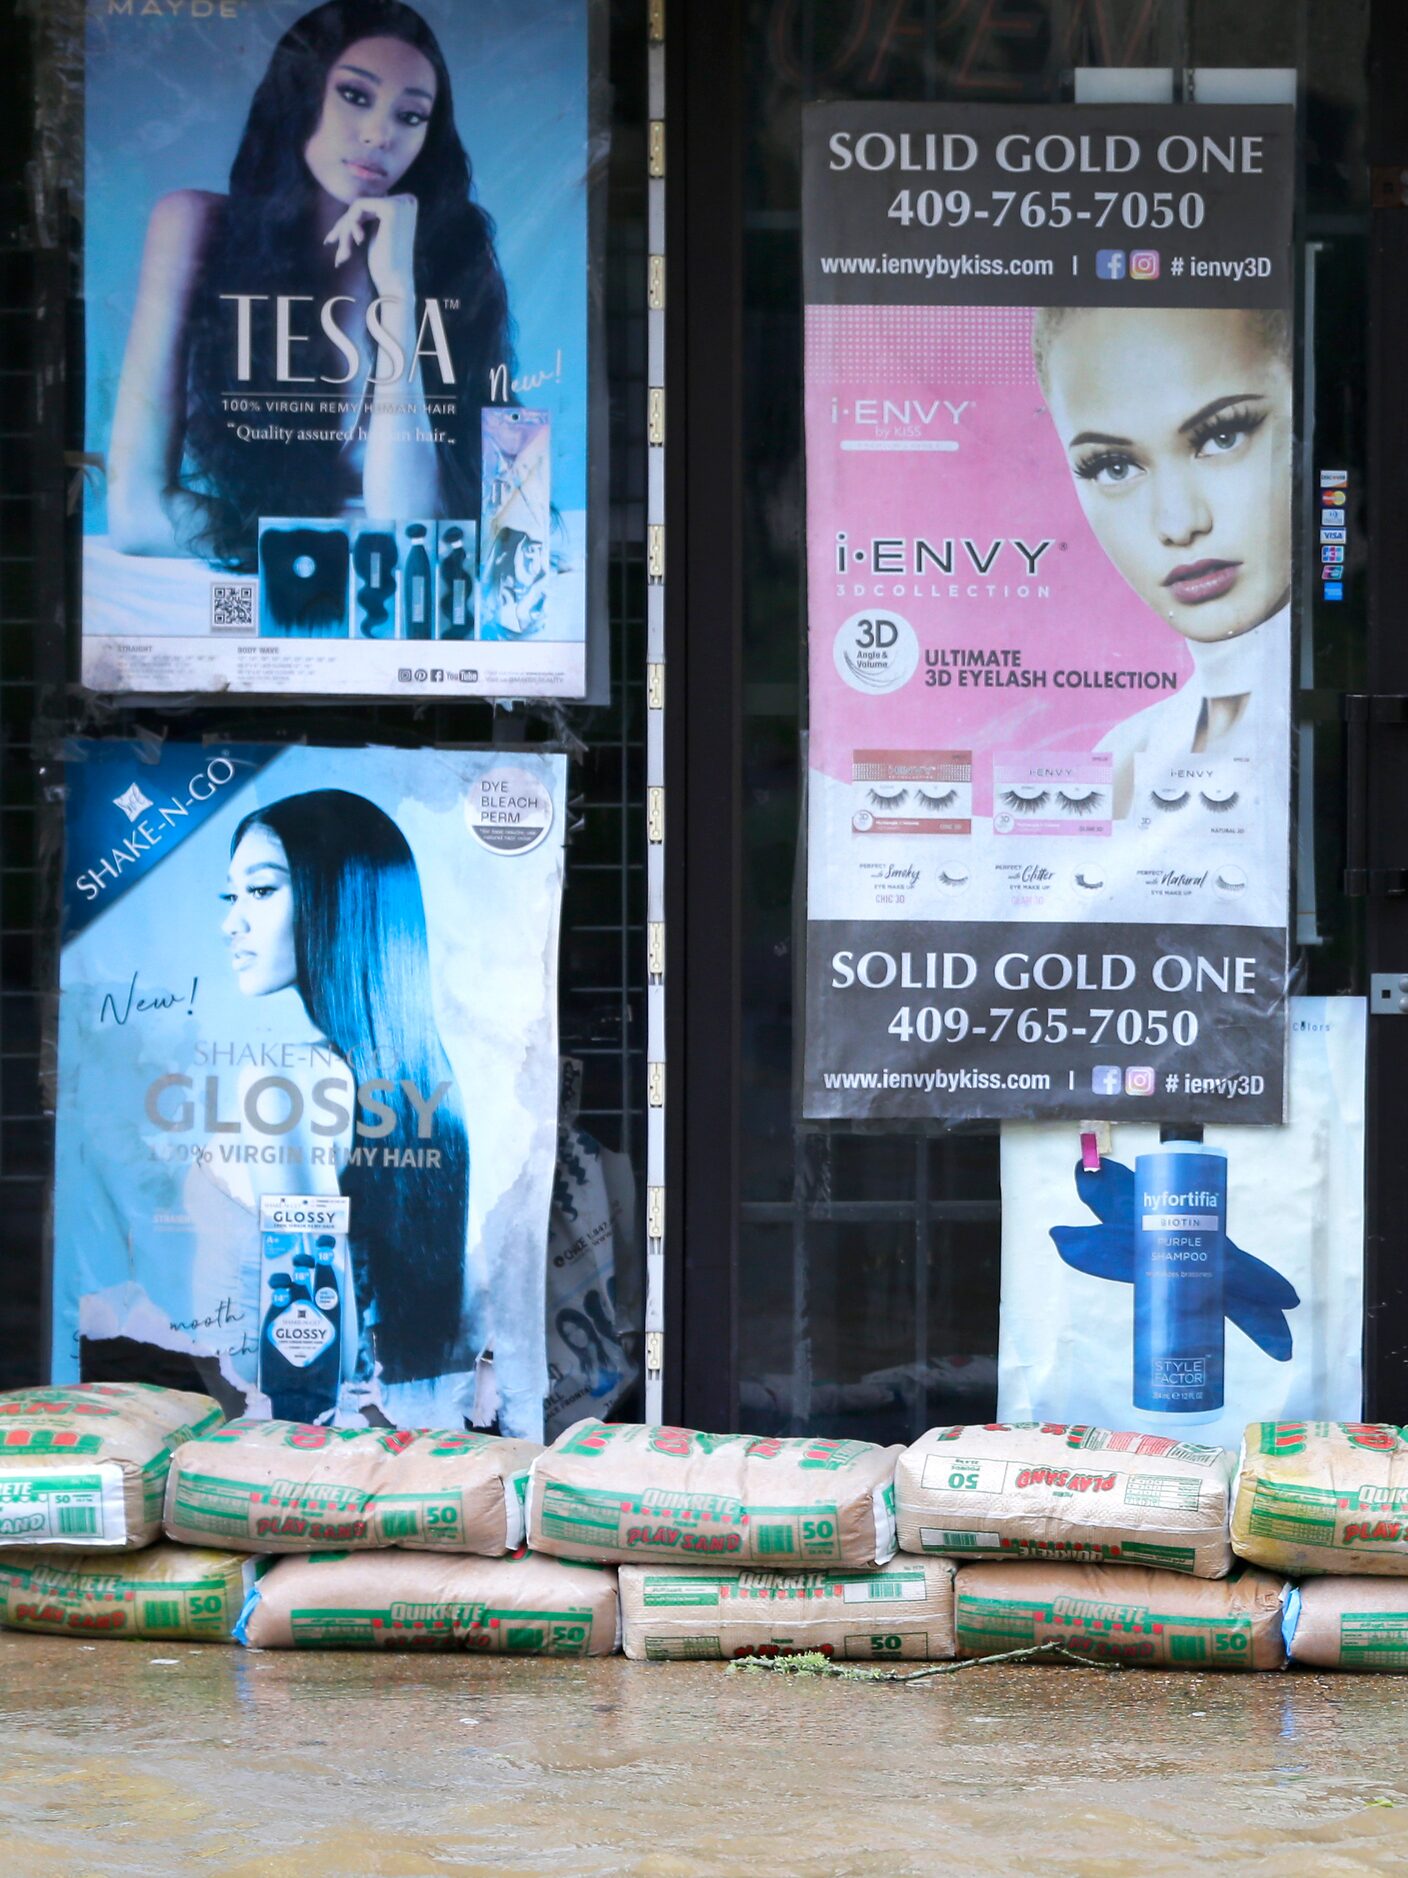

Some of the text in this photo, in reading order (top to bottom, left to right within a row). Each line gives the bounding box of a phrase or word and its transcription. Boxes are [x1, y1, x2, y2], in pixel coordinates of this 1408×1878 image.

[829, 132, 1263, 174] SOLID GOLD ONE
[887, 189, 1205, 229] 409-765-7050
[821, 255, 1271, 281] www.ienvybykiss.com ienvy3D
[488, 349, 562, 402] New!
[222, 401, 260, 412] 100%
[266, 402, 314, 413] VIRGIN
[320, 402, 357, 414] REMY
[423, 404, 456, 414] HAIR
[297, 426, 352, 441] assured
[855, 619, 898, 648] 3D
[857, 651, 880, 660] Angle
[857, 660, 888, 669] Volume
[925, 649, 1021, 667] ULTIMATE
[925, 671, 1177, 690] 3D EYELASH COLLECTION
[481, 781, 509, 793] DYE
[481, 796, 538, 809] BLEACH
[481, 811, 521, 823] PERM
[75, 757, 235, 901] SHAKE-N-GO
[885, 864, 920, 882] Smoky
[1021, 865, 1055, 882] Glitter
[1161, 871, 1207, 888] Natural
[831, 950, 1256, 995] SOLID GOLD ONE
[100, 973, 200, 1027] New!
[888, 1007, 1199, 1046] 409-765-7050
[824, 1069, 1264, 1097] www.ienvybykiss.com ienvy3D
[144, 1073, 453, 1139] GLOSSY
[219, 1144, 304, 1165] VIRGIN
[384, 1147, 442, 1169] HAIR
[273, 1211, 335, 1223] GLOSSY
[1160, 1219, 1200, 1227] BIOTIN
[1158, 1237, 1202, 1247] PURPLE
[1151, 1252, 1208, 1262] SHAMPOO
[276, 1328, 328, 1339] GLOSSY
[1155, 1361, 1202, 1372] STYLE
[1155, 1373, 1204, 1385] FACTOR
[271, 1479, 367, 1504] QUIKRETE
[643, 1489, 739, 1514] QUIKRETE
[427, 1506, 458, 1524] 50
[804, 1520, 833, 1539] 50
[1343, 1522, 1400, 1543] PLAY
[628, 1528, 740, 1552] PLAY SAND
[740, 1572, 828, 1588] QUIKRETE
[189, 1596, 222, 1615] 50
[390, 1602, 486, 1622] QUIKRETE
[1054, 1598, 1147, 1622] QUIKRETE
[553, 1626, 586, 1643] 50
[871, 1635, 901, 1650] 50
[1215, 1633, 1247, 1650] 50
